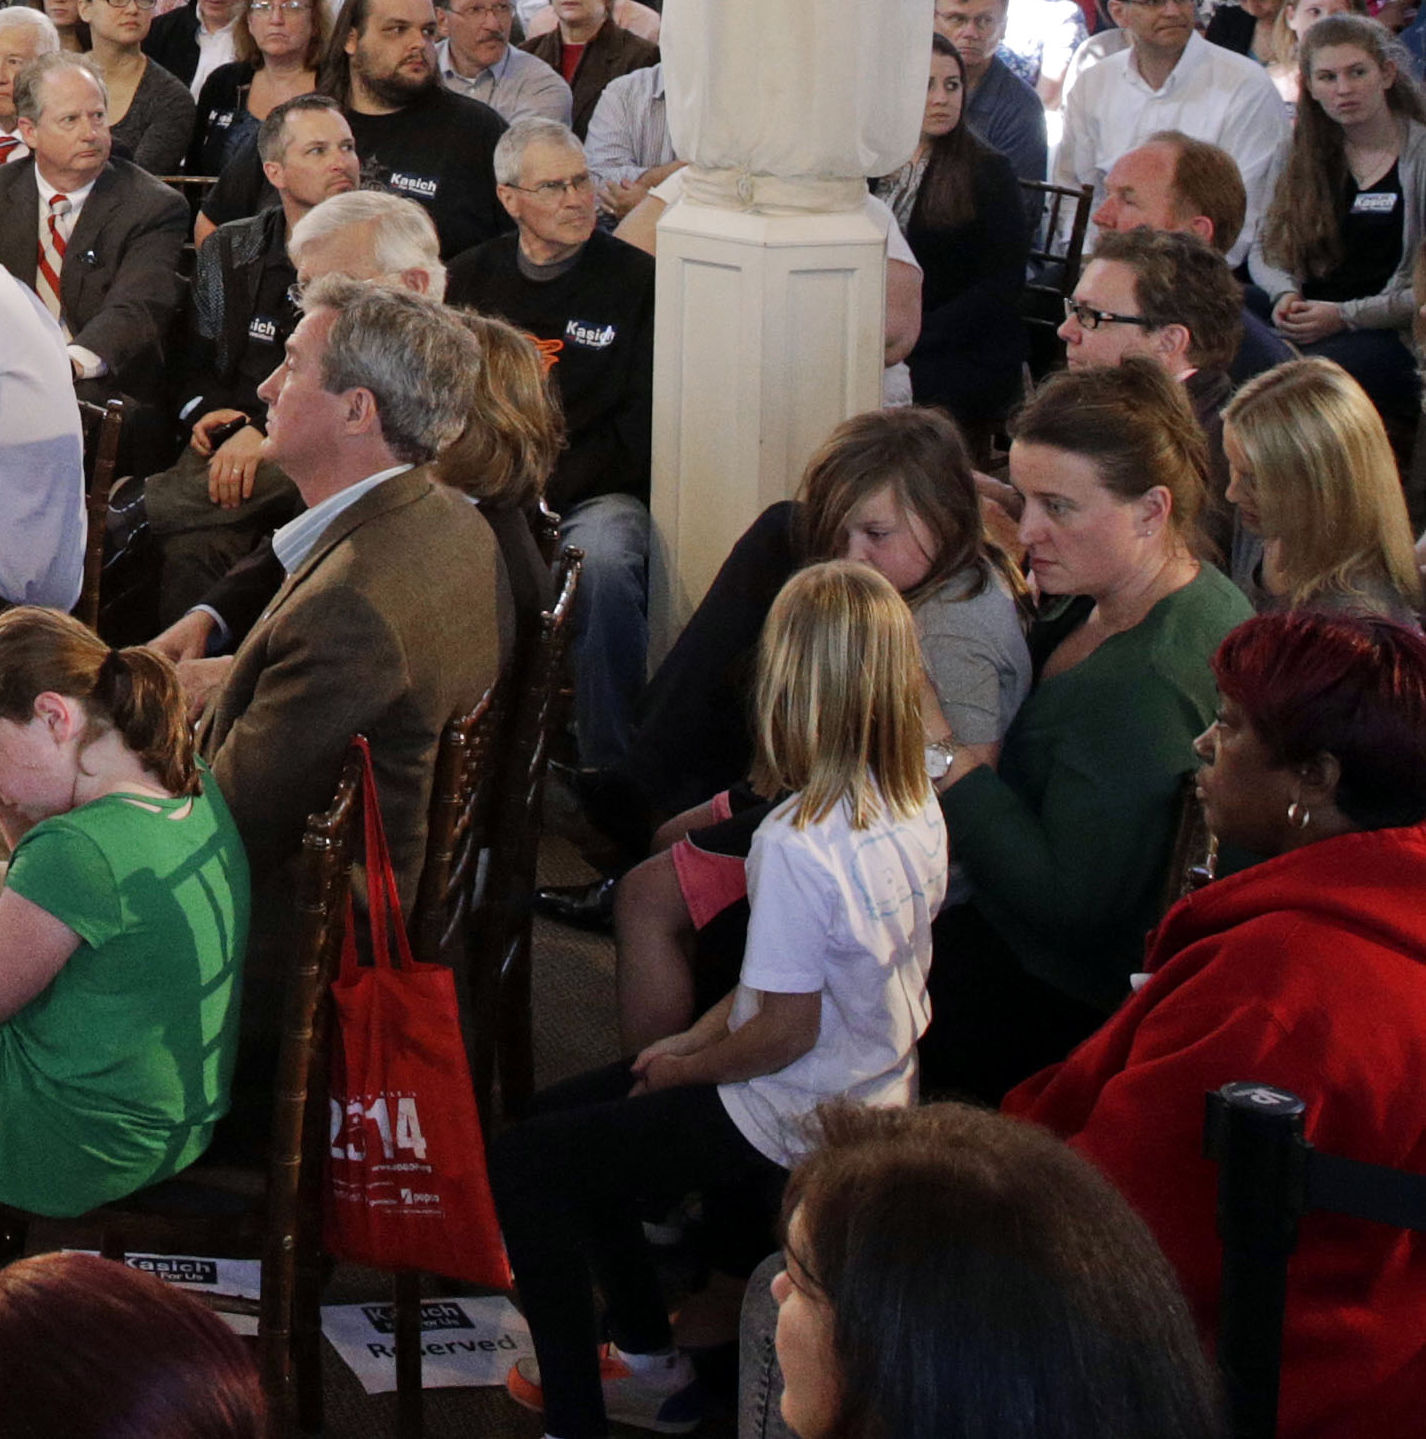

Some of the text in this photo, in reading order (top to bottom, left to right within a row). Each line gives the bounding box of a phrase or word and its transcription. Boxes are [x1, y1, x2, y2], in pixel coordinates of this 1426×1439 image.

[390, 172, 438, 192] Kasich
[250, 317, 276, 336] ich
[185, 1272, 204, 1281] Us
[368, 1304, 459, 1322] Kich
[367, 1334, 519, 1359] Rerved
